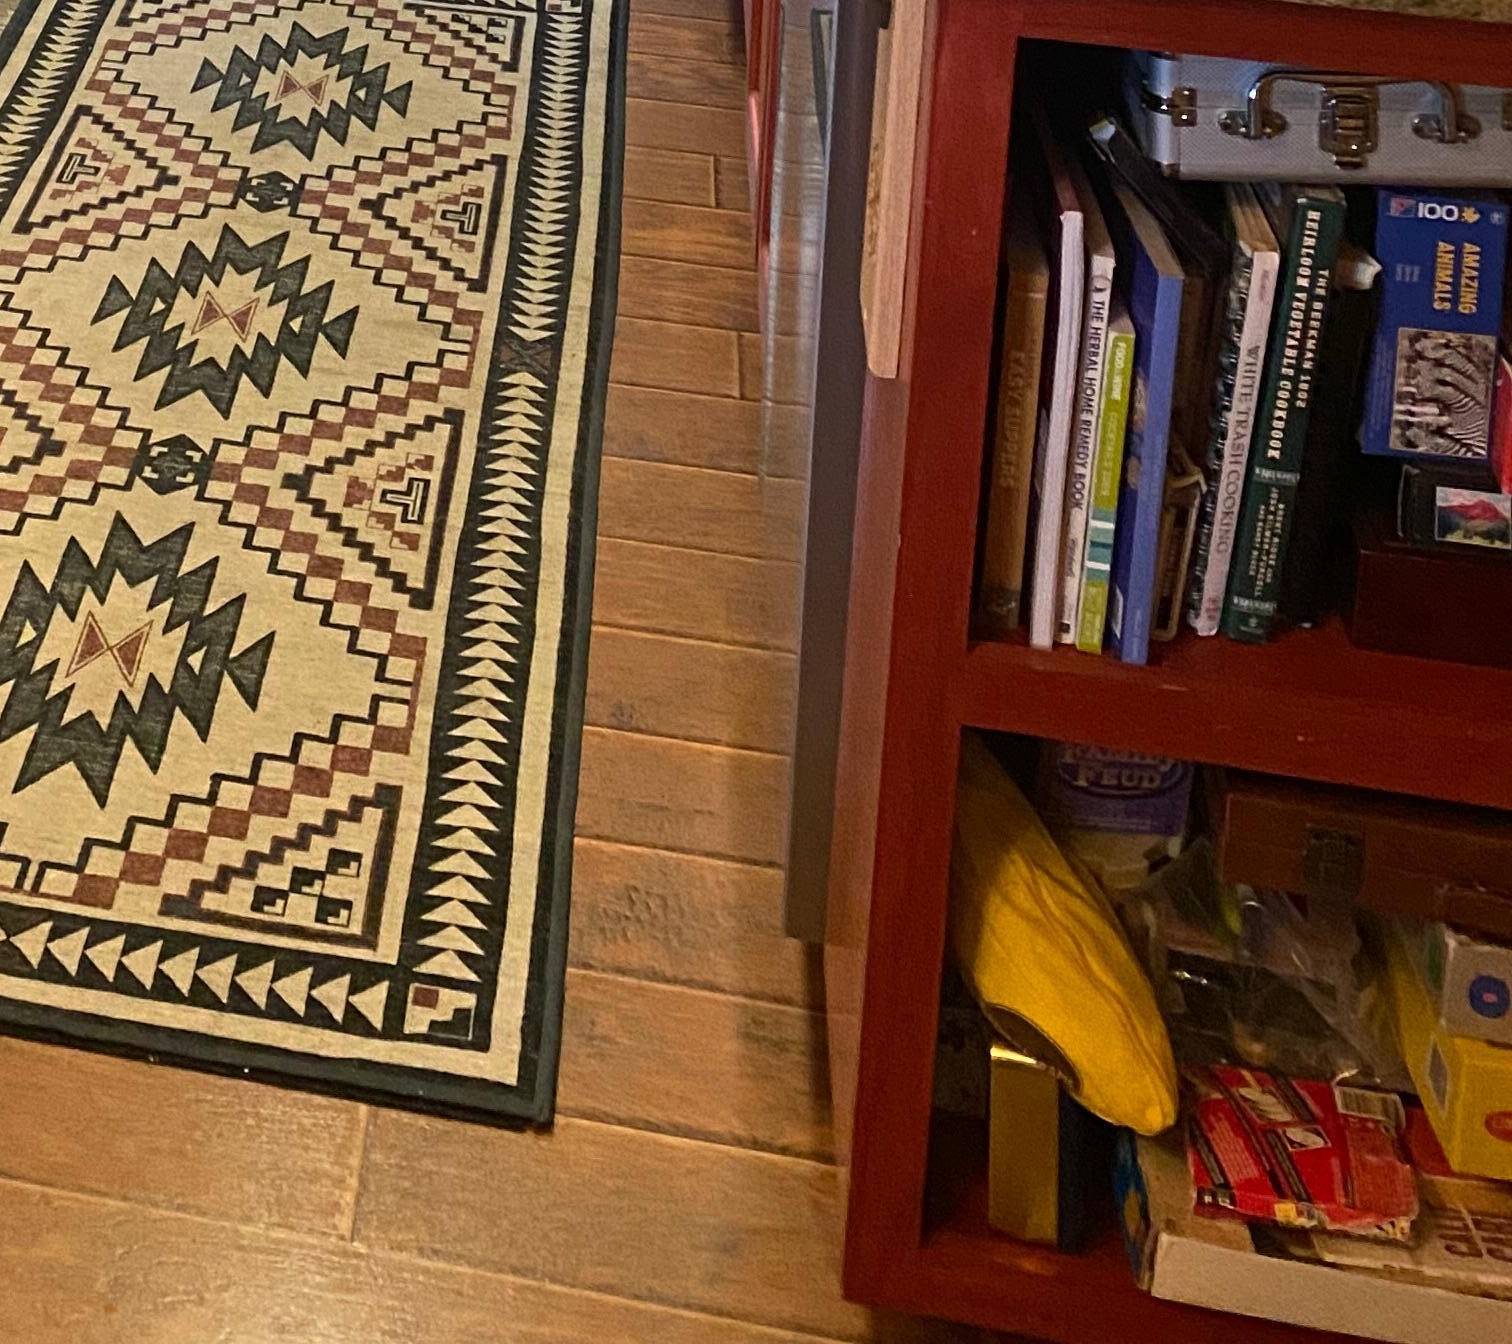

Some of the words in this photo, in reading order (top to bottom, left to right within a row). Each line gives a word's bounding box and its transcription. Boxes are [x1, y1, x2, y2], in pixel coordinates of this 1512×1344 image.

[1418, 202, 1459, 221] 100
[1296, 210, 1321, 288] HEIRLOOM
[1433, 240, 1455, 310] ANIMALS
[1315, 268, 1329, 296] THE
[1458, 242, 1481, 314] AMAZING
[1093, 299, 1106, 323] THE
[1281, 292, 1308, 376] VEGETABLE
[1302, 302, 1324, 370] BEEKMAN
[1006, 350, 1025, 401] EASY
[1087, 325, 1103, 379] HERBAL
[1115, 342, 1126, 369] FOOD
[1240, 345, 1260, 403] WHITE
[1082, 381, 1098, 419] HOME
[1267, 380, 1292, 460] COOKBOOK
[998, 408, 1021, 488] SUPPERS
[1076, 419, 1093, 472] REMEDY
[1228, 407, 1250, 465] TRASH
[1071, 472, 1086, 511] BOOK
[1216, 470, 1239, 554] COOKING
[1071, 766, 1161, 790] FEUD
